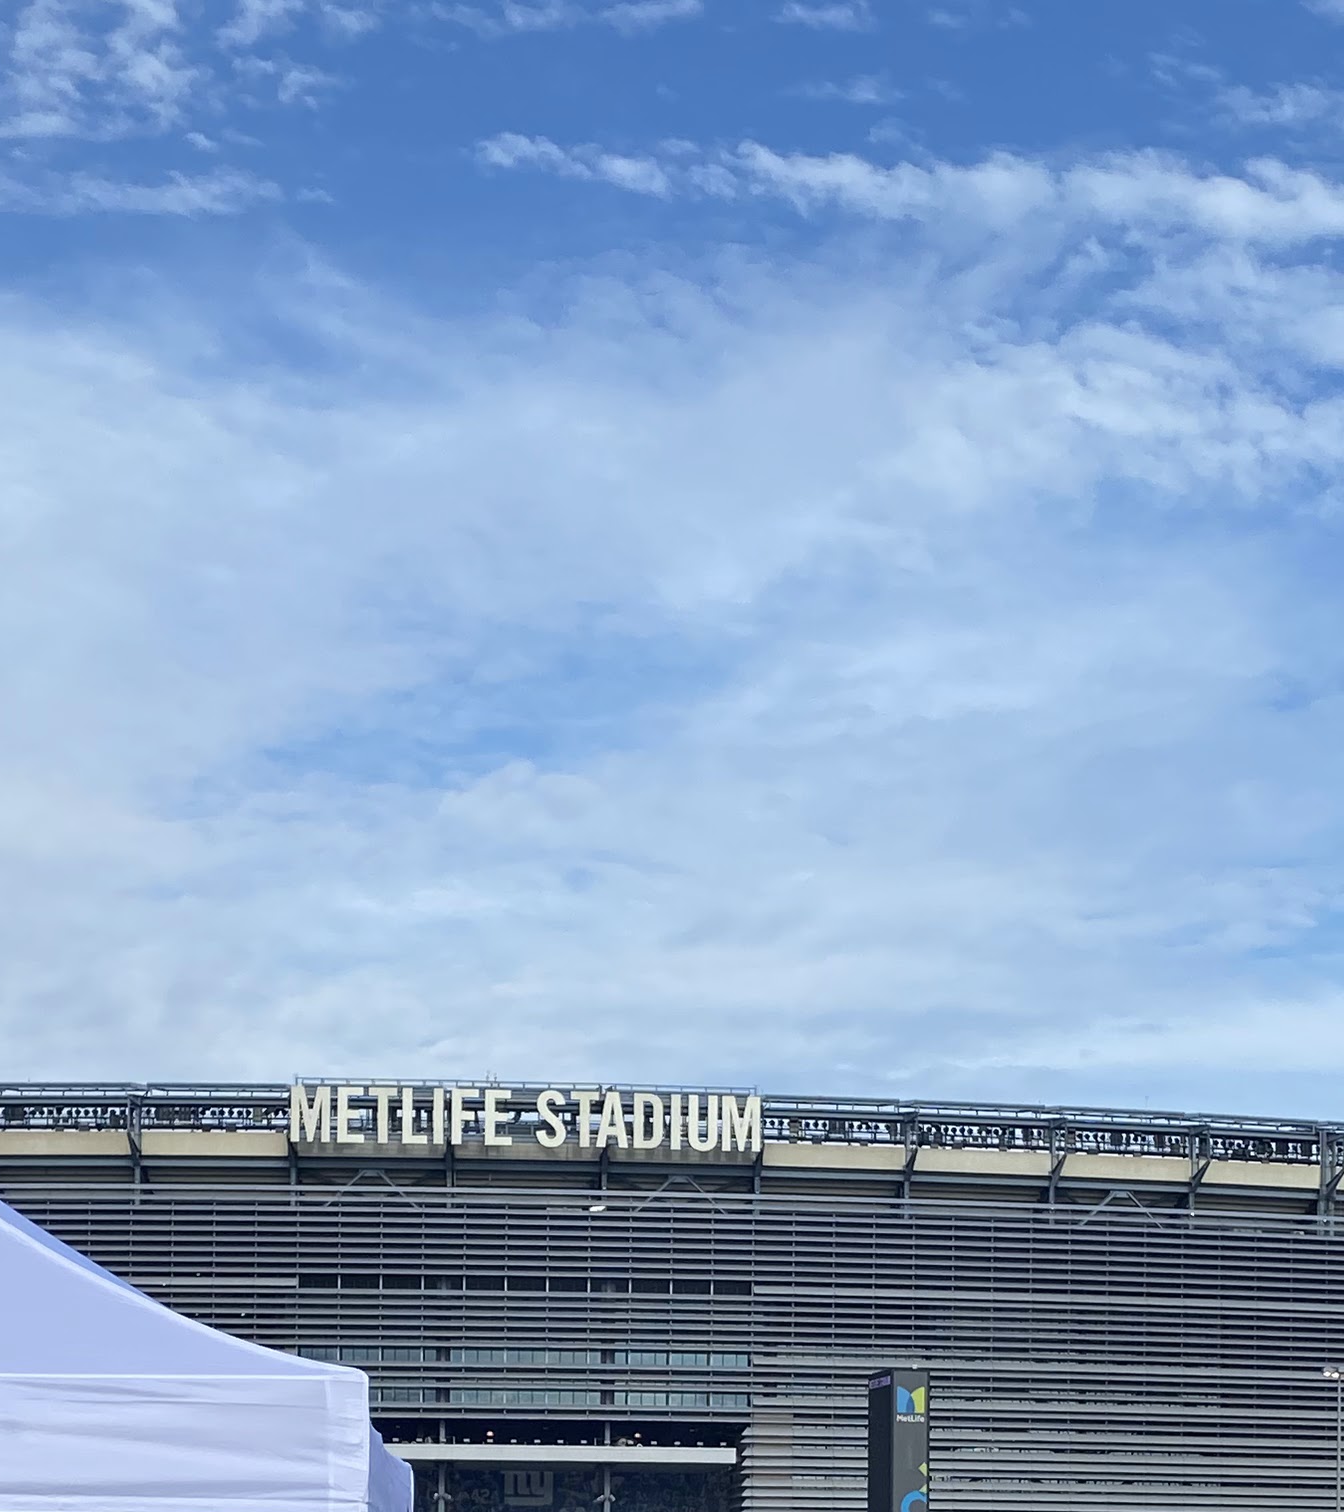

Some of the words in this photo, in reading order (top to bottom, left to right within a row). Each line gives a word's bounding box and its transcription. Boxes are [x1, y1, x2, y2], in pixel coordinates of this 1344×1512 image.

[289, 1085, 513, 1146] METLIFE
[535, 1089, 761, 1153] STADIUM
[896, 1413, 926, 1424] MetLife
